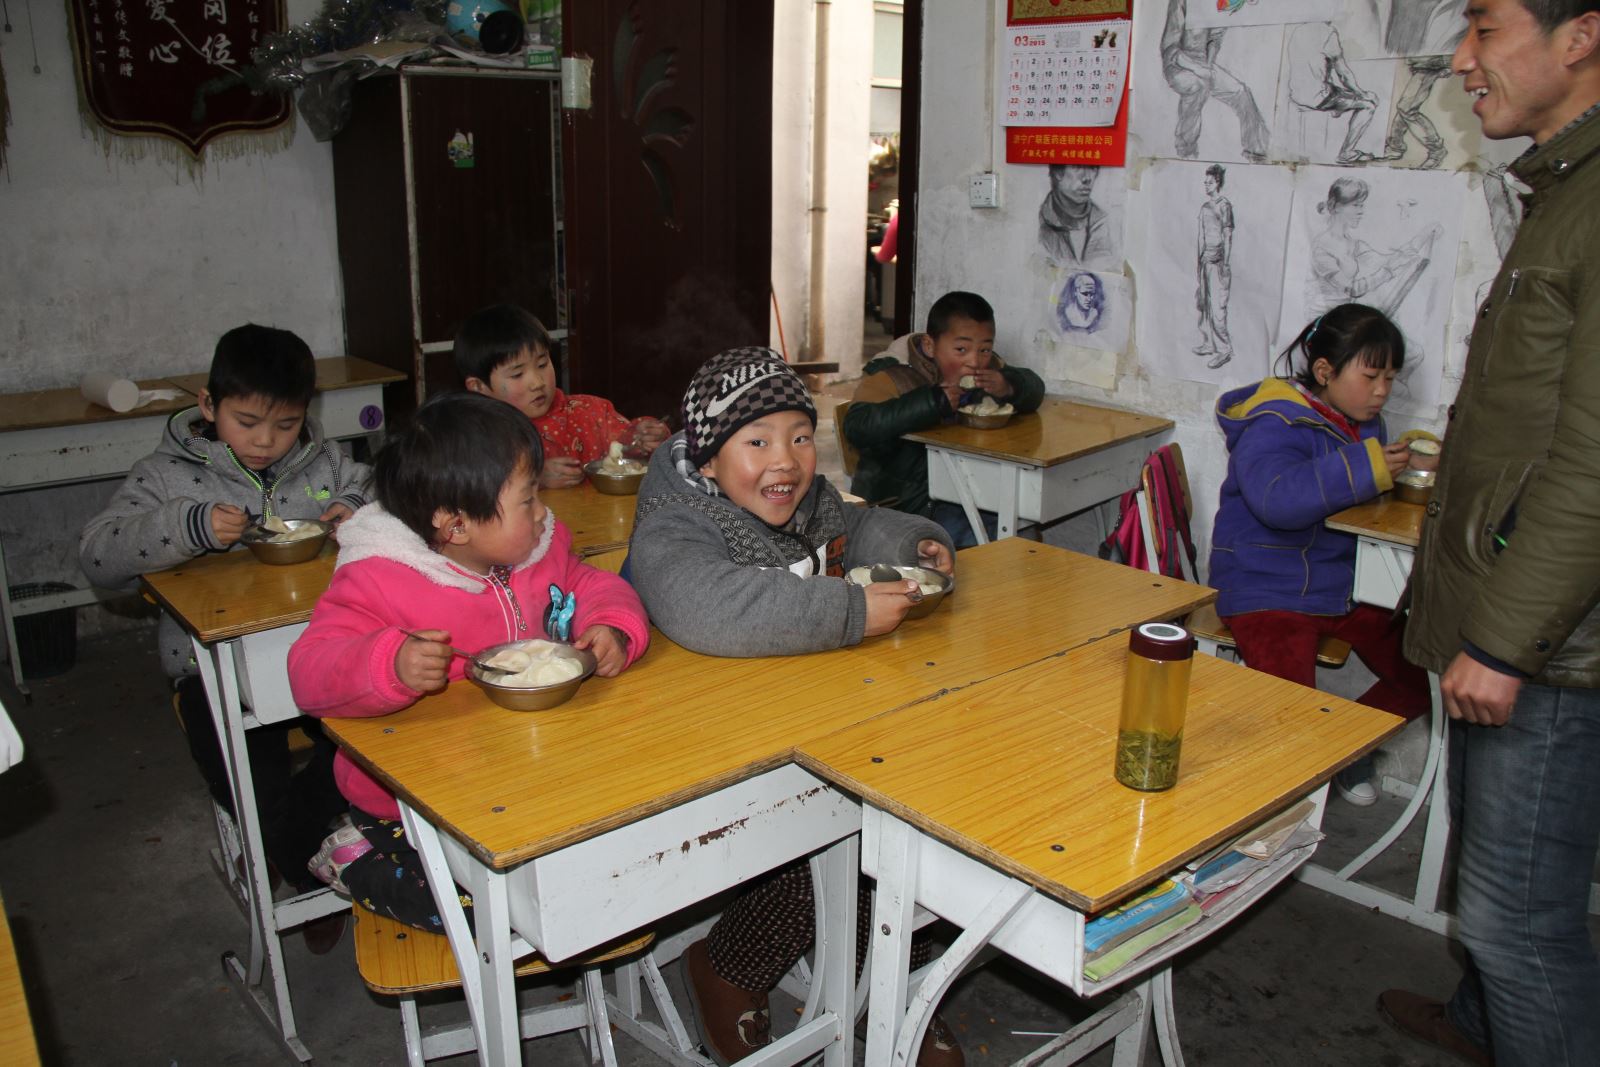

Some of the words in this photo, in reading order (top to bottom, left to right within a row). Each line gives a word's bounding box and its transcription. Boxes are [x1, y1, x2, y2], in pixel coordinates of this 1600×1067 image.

[1014, 35, 1029, 47] 03
[721, 362, 781, 394] NIKE
[366, 406, 376, 427] 8
